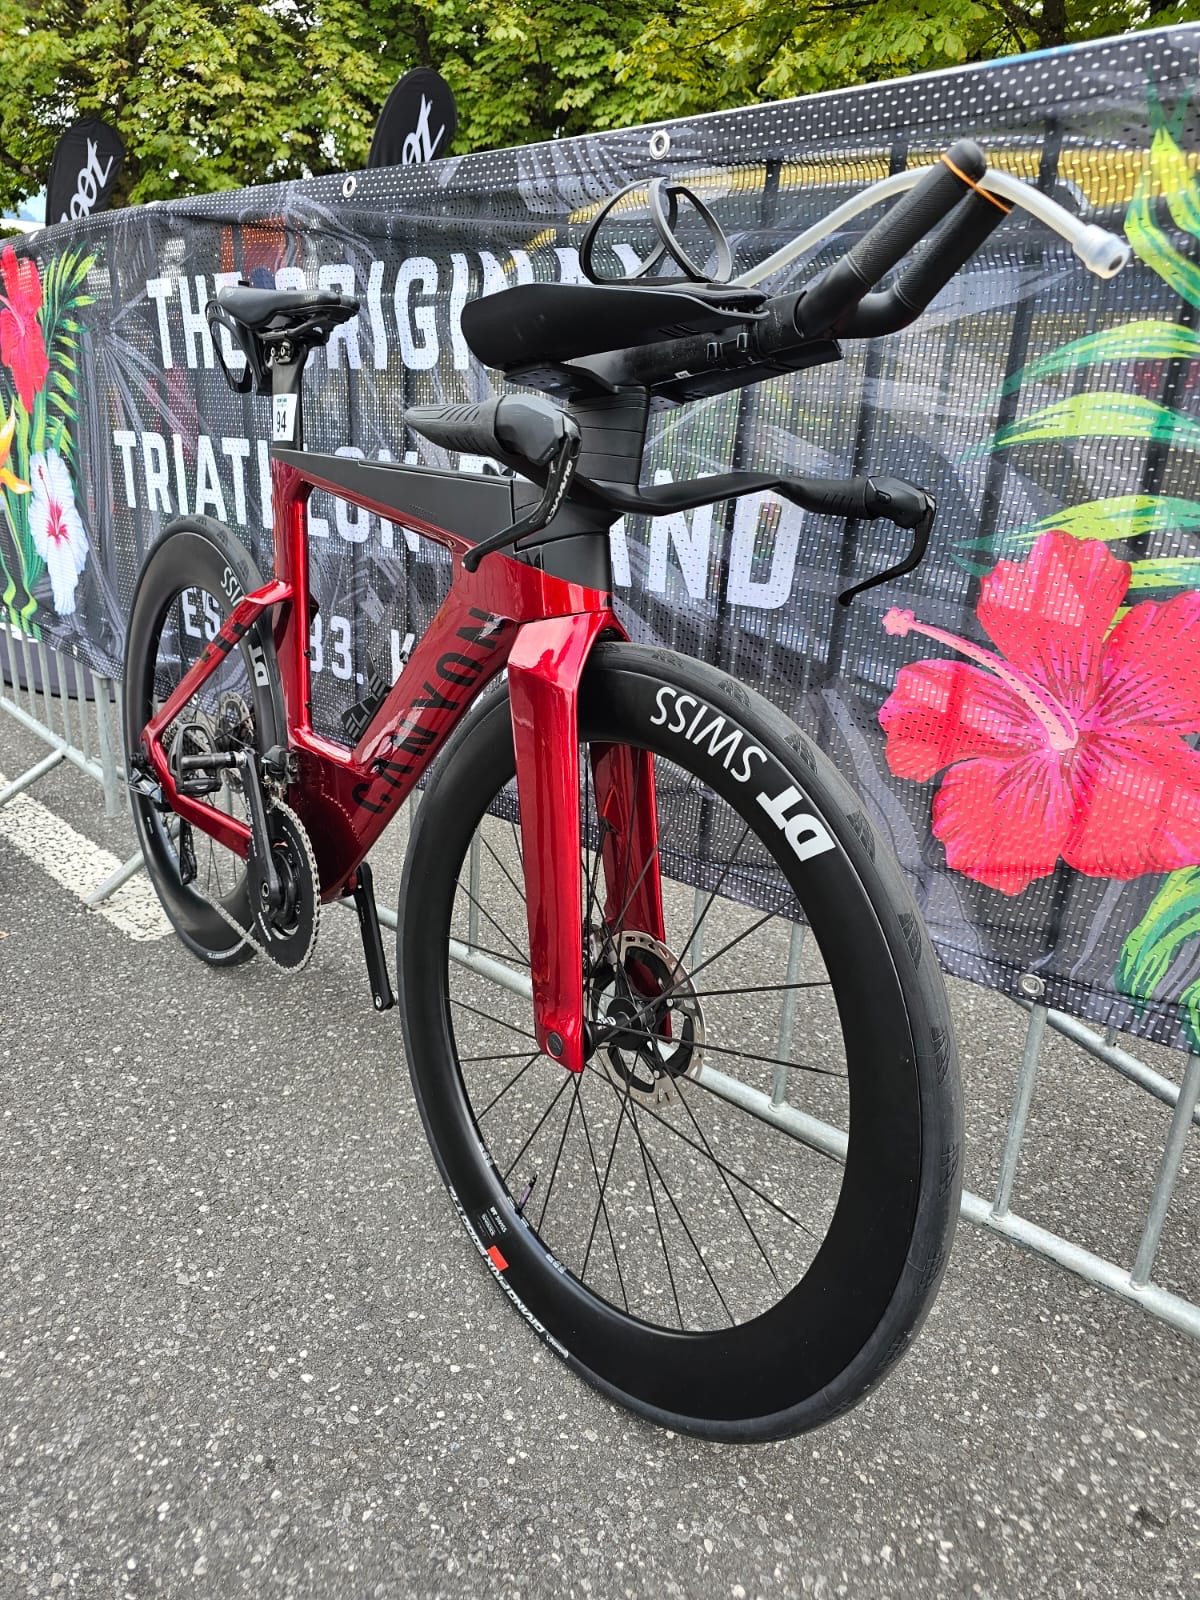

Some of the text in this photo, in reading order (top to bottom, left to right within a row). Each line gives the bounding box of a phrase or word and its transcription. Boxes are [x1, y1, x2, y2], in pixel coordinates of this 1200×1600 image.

[146, 271, 248, 369] THE
[276, 410, 287, 433] 94
[352, 607, 505, 815] CANYON
[649, 686, 837, 862] DT SWISS
